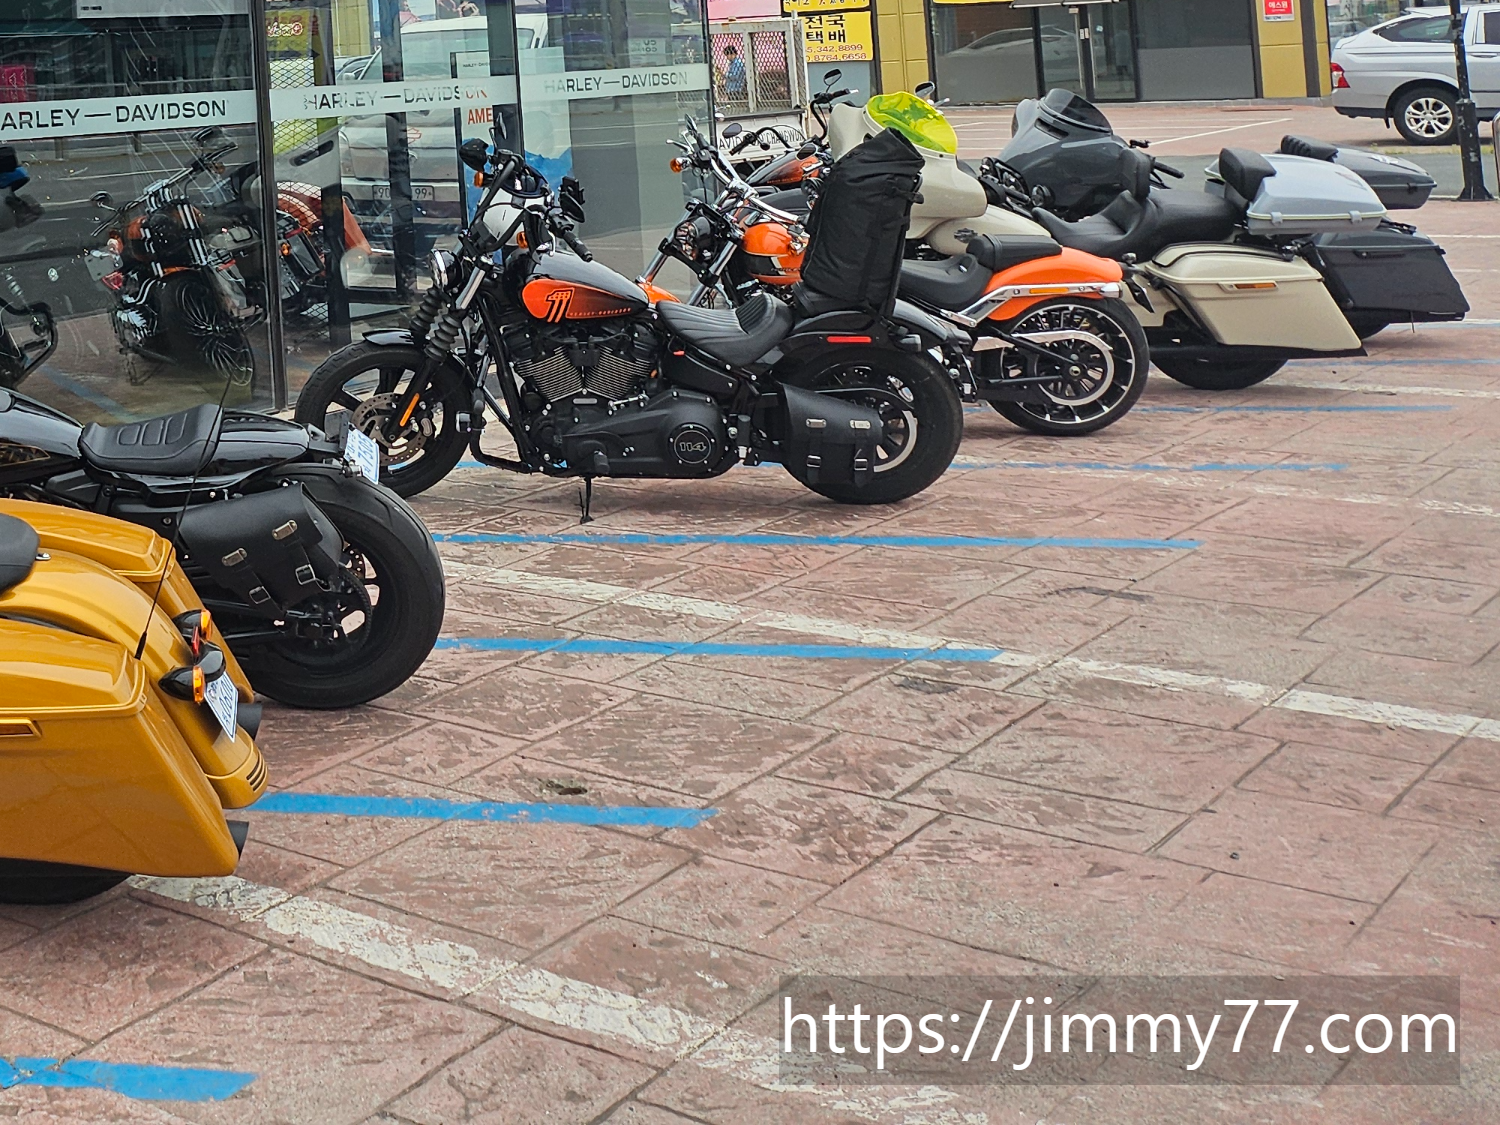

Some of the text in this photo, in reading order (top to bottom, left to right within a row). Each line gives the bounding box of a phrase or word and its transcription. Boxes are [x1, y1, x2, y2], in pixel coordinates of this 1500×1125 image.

[545, 72, 688, 93] HARLEY DAVIDSON
[115, 99, 227, 123] DAVIDSON
[679, 441, 708, 452] 114
